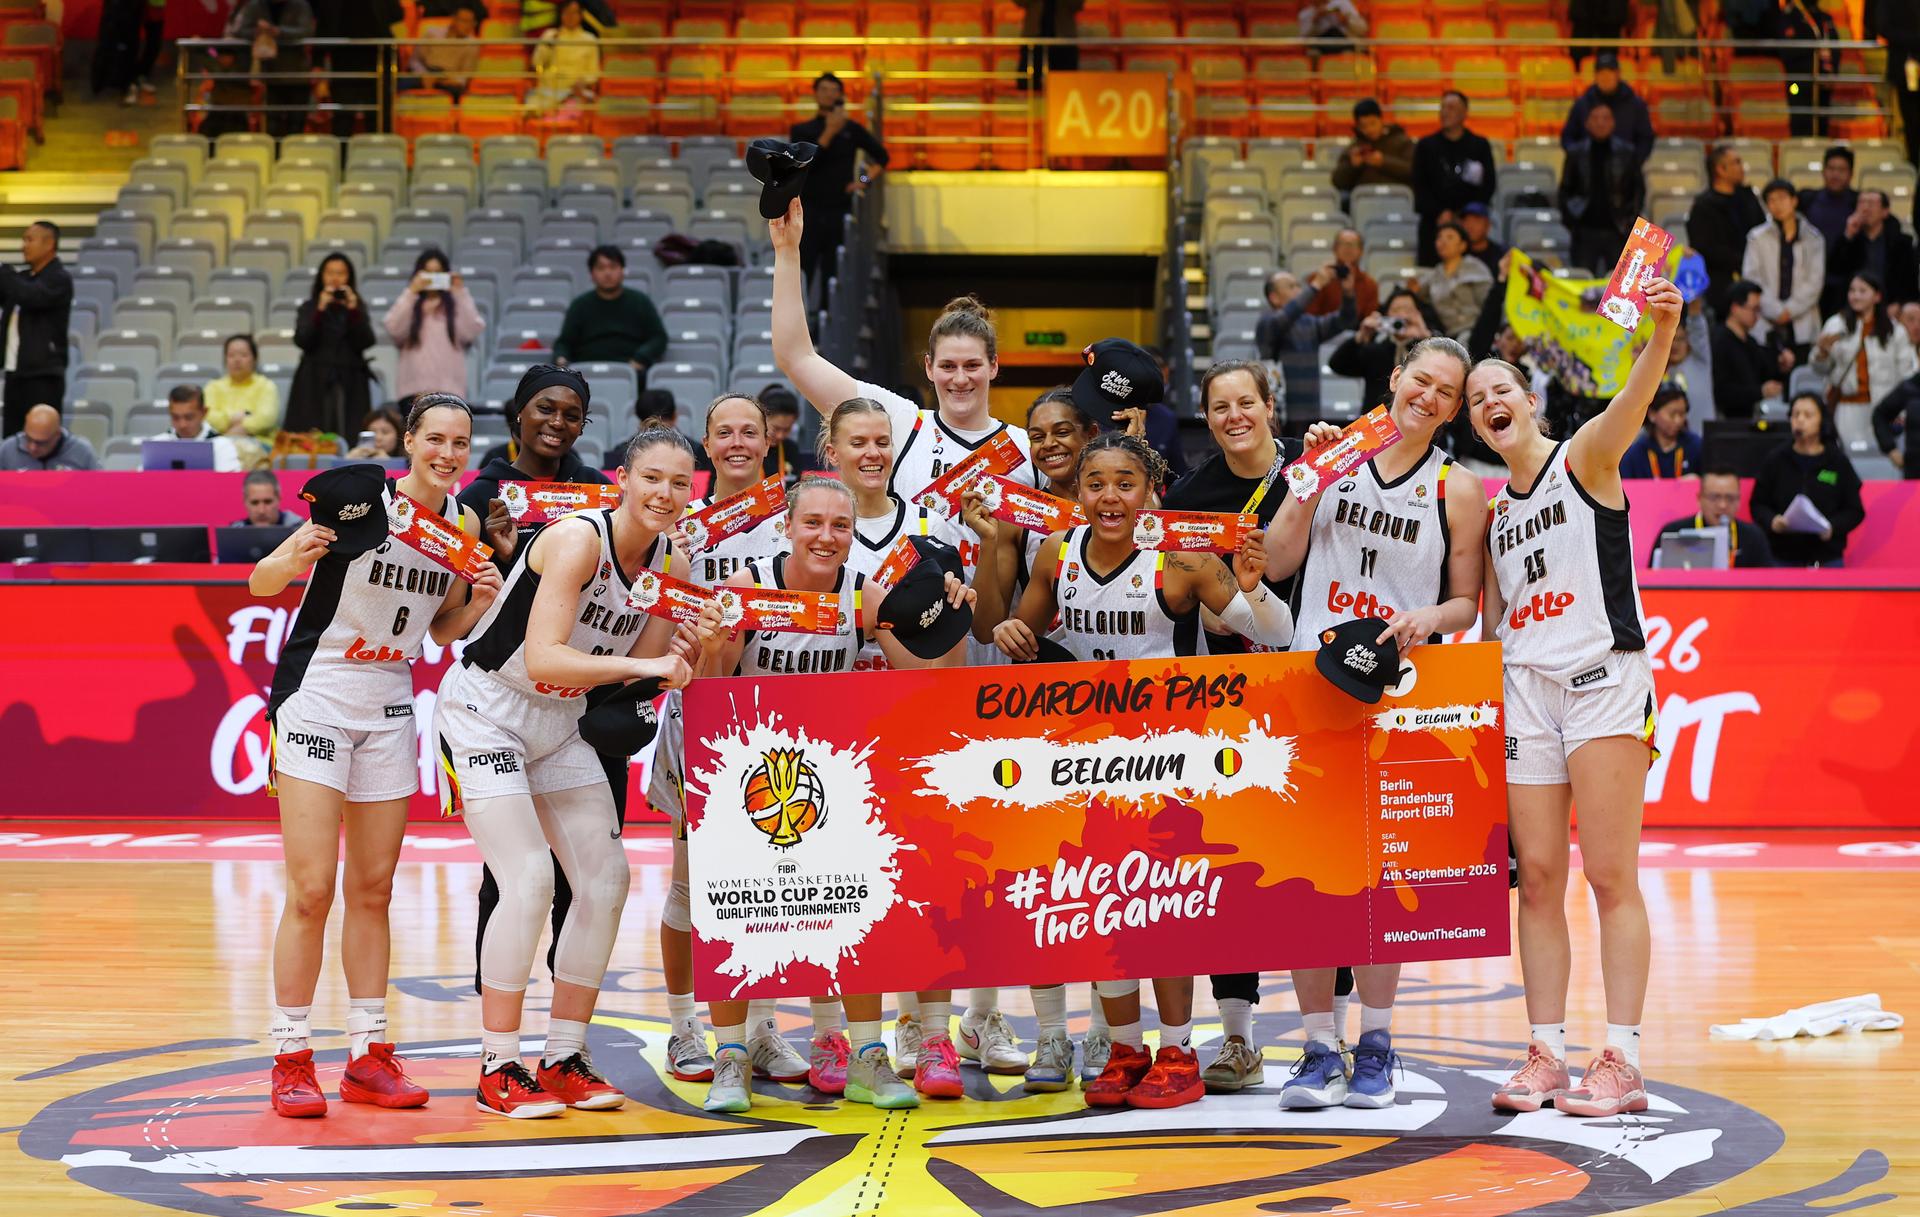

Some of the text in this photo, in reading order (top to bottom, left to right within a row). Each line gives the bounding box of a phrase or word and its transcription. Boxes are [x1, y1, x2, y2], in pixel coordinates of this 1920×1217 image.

[1334, 499, 1421, 544] BELGIUM
[1497, 500, 1567, 557] BELGIUM
[1361, 547, 1378, 579] 11
[1524, 547, 1547, 585] 25
[369, 560, 450, 597] BELGIUM
[1327, 580, 1396, 620] Lotto
[1509, 591, 1575, 630] Lotto
[392, 606, 411, 636] 6
[1065, 606, 1146, 635] BELGIUM
[344, 635, 415, 661] Lott
[1353, 643, 1377, 660] #We
[757, 646, 847, 673] BELGIUM
[1344, 656, 1374, 676] Game!
[976, 673, 1247, 720] BOARDING PASS
[1415, 713, 1461, 725] BELGIUM
[287, 732, 336, 750] POWER
[307, 745, 335, 762] ADE
[468, 751, 515, 768] POWER
[494, 761, 520, 775] ADE
[1051, 754, 1185, 786] BELGIUM
[1380, 780, 1413, 792] Berlin
[1380, 792, 1454, 806] Brandenburg
[1380, 804, 1454, 821] Airport (BER)
[1382, 841, 1409, 854] 26W
[778, 865, 796, 873] FIBA
[1383, 864, 1497, 882] 4th September 2026
[707, 873, 868, 889] WOMEN'S BASKETBALL
[708, 885, 868, 906] WORLD CUP 2026
[716, 902, 860, 920] QUALIFYING TOURNAMENTS
[1384, 927, 1486, 943] #WeOwnTheGame
